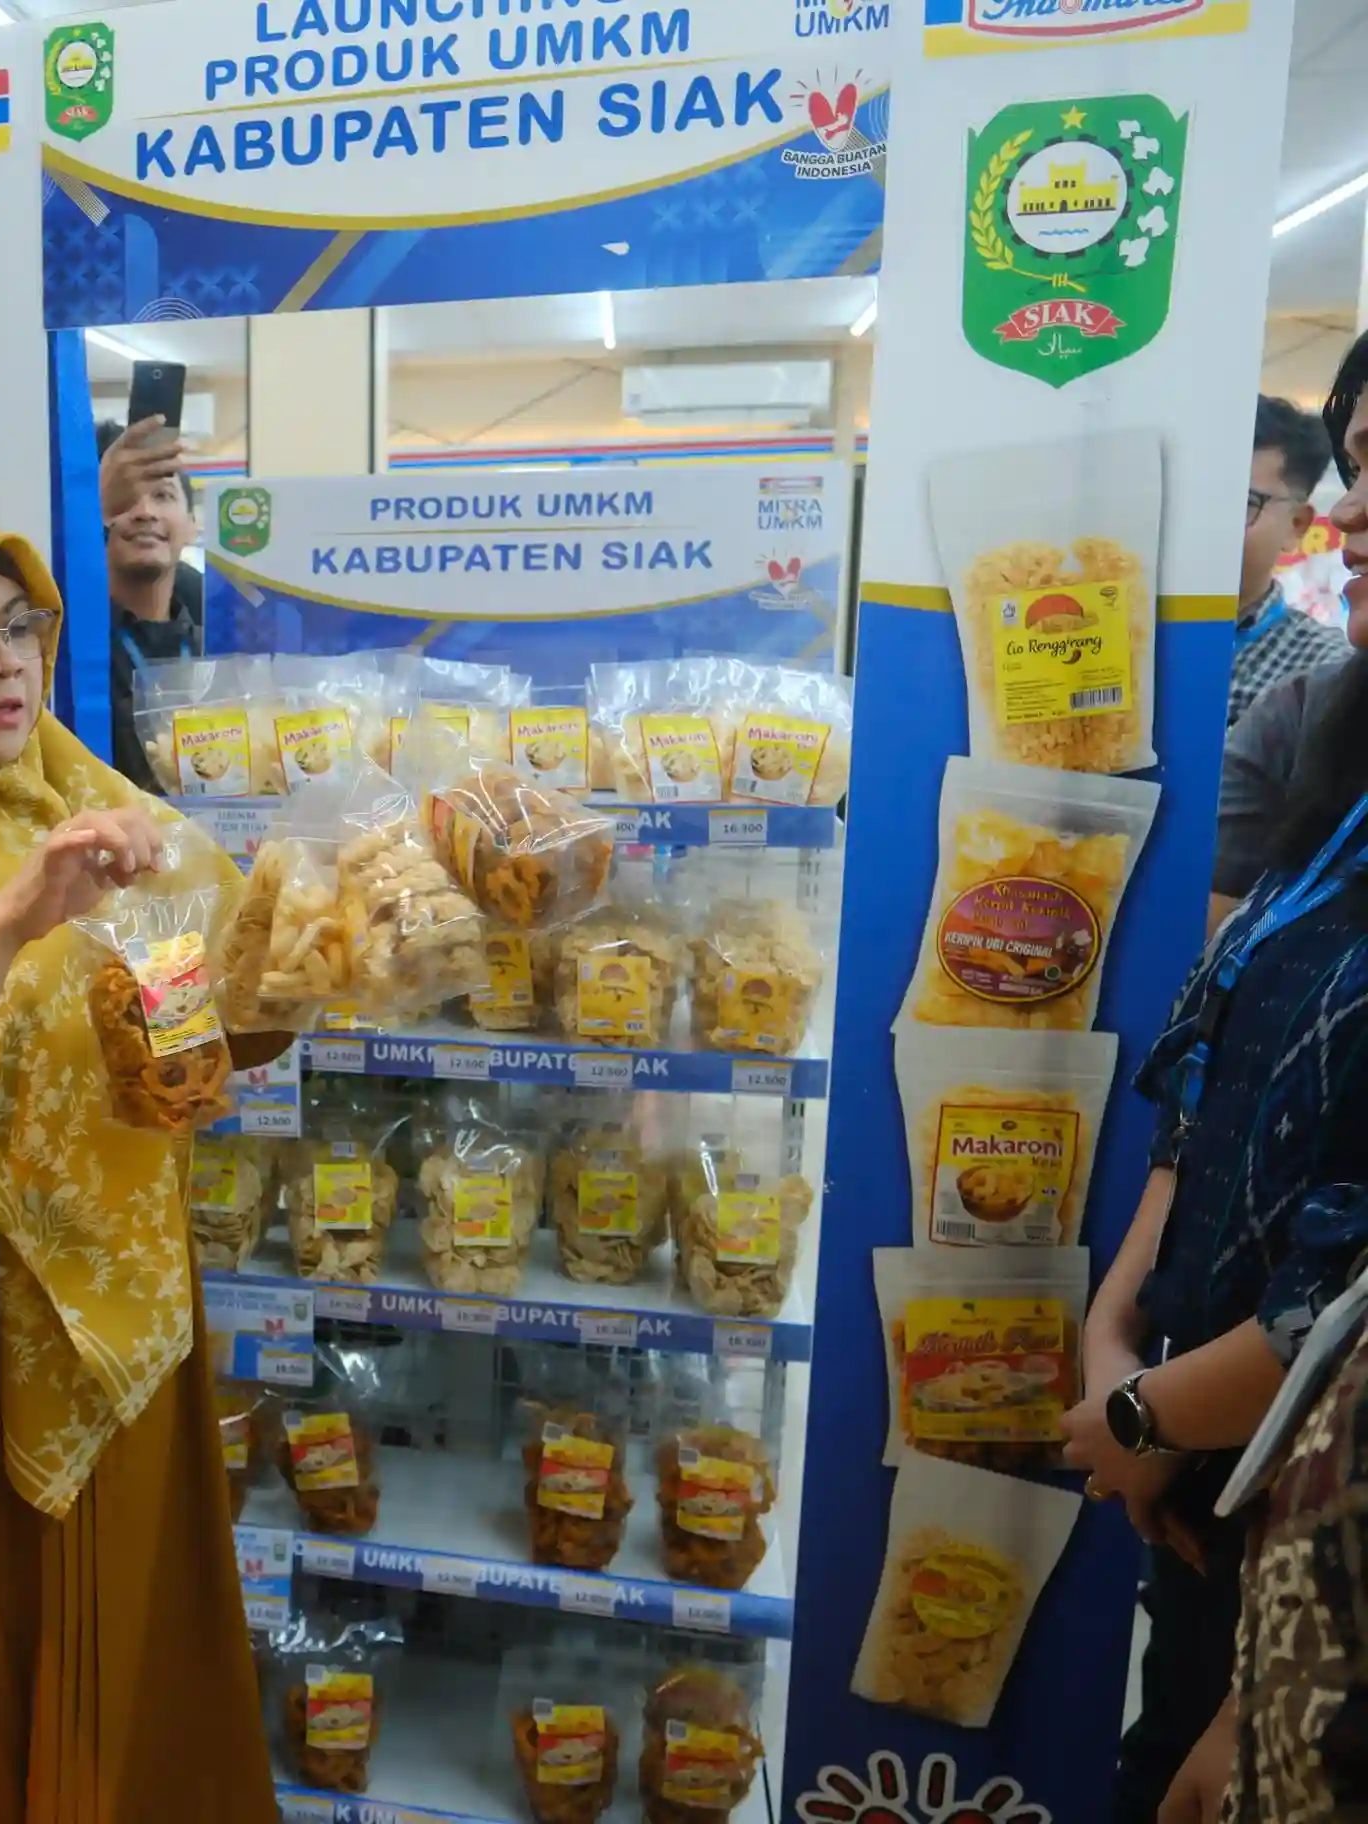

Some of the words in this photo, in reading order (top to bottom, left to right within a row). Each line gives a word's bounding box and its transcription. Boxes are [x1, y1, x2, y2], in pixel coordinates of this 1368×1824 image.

[795, 3, 890, 37] UMKM
[204, 35, 460, 100] PRODUK
[488, 8, 691, 71] UMKM
[135, 90, 565, 181] KABUPATEN
[597, 69, 783, 139] SIAK
[783, 150, 834, 165] BANGGA
[837, 143, 887, 164] BUATAN
[797, 161, 872, 178] INDONESIA
[1024, 302, 1095, 329] SIAK
[370, 494, 523, 521] PRODUK
[536, 491, 654, 518] UMKM
[758, 499, 823, 514] MITRA
[758, 514, 823, 530] UMKM
[312, 542, 581, 575] KABUPATEN
[601, 540, 713, 571] SIAK
[638, 810, 673, 829] AK
[633, 1057, 670, 1077] AK
[952, 1134, 1063, 1157] Makaroni
[497, 1305, 584, 1328] BUPATE
[638, 1318, 672, 1337] AK
[615, 1583, 645, 1606] AK
